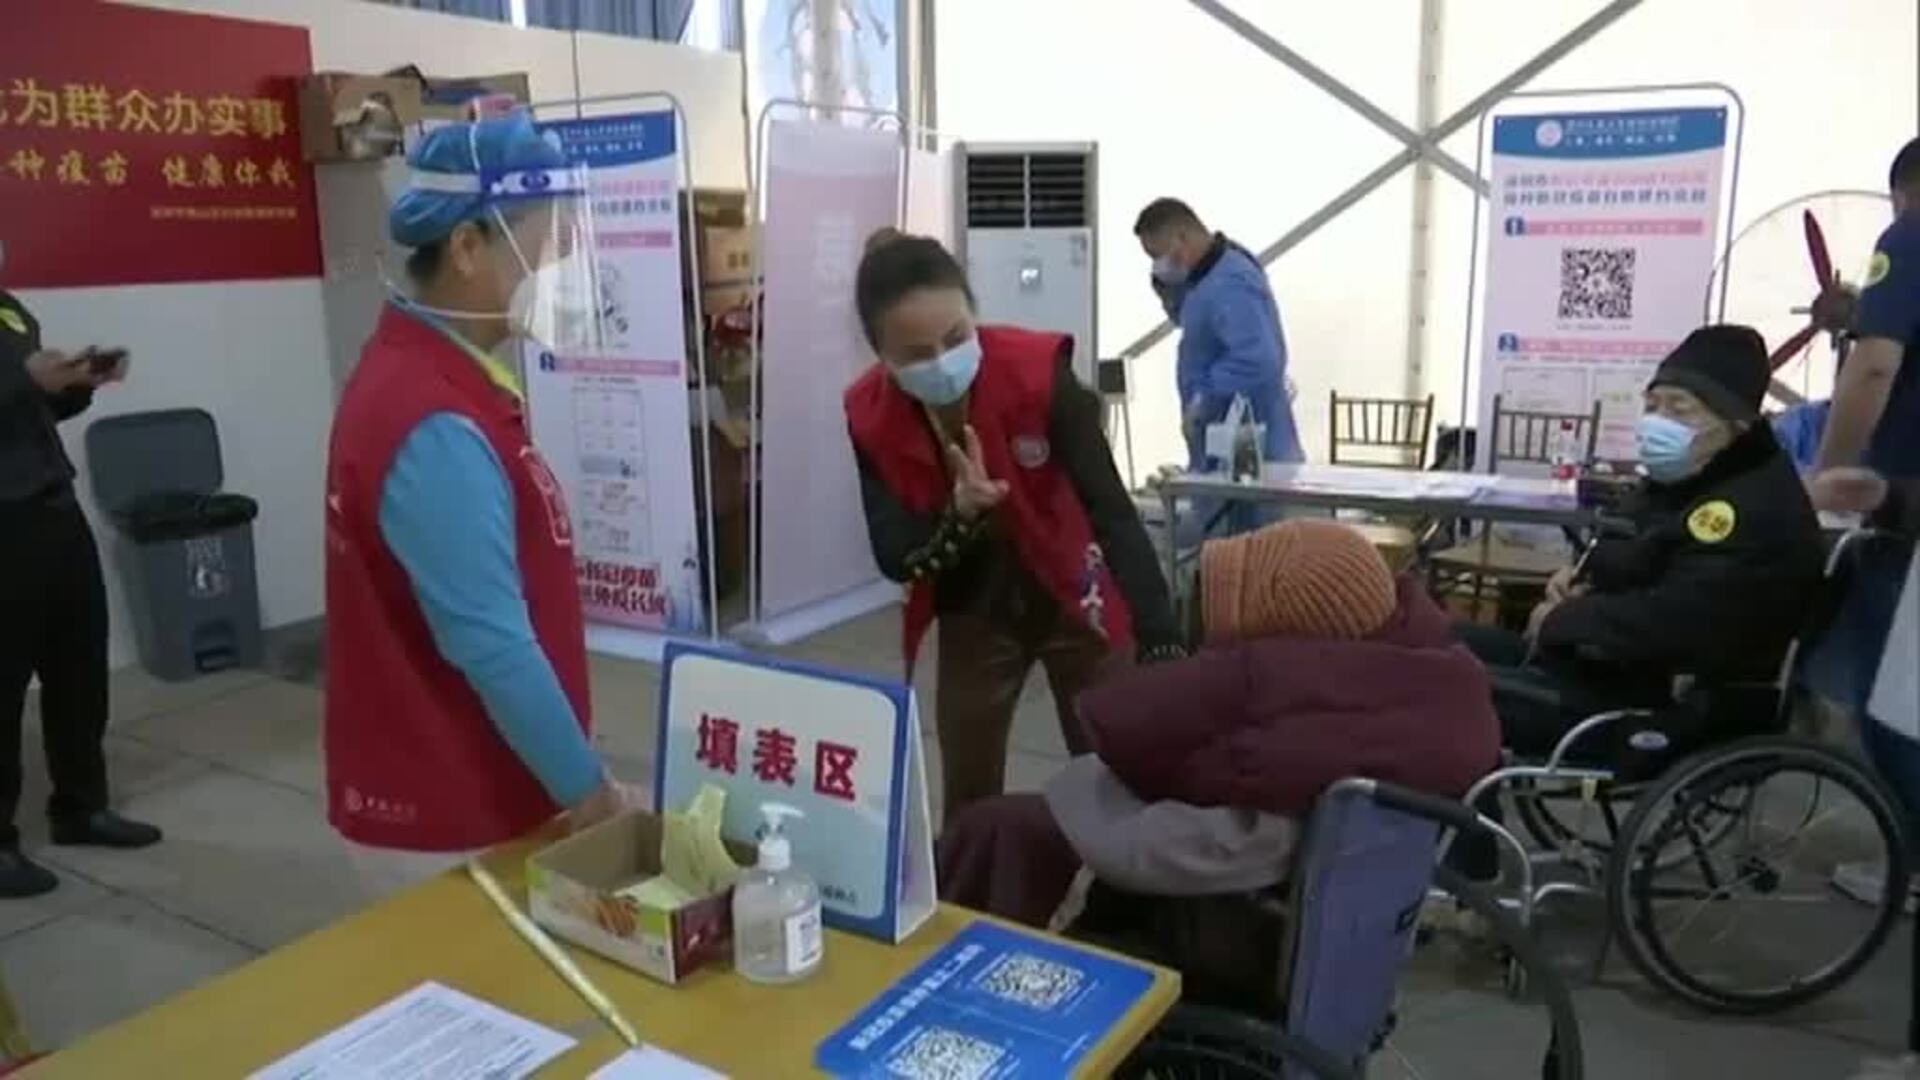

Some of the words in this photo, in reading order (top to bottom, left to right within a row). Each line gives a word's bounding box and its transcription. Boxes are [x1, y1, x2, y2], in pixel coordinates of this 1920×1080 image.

[0, 78, 286, 139] 为群众办实事
[0, 149, 130, 187] 种疫苗
[695, 713, 859, 801] 填表区
